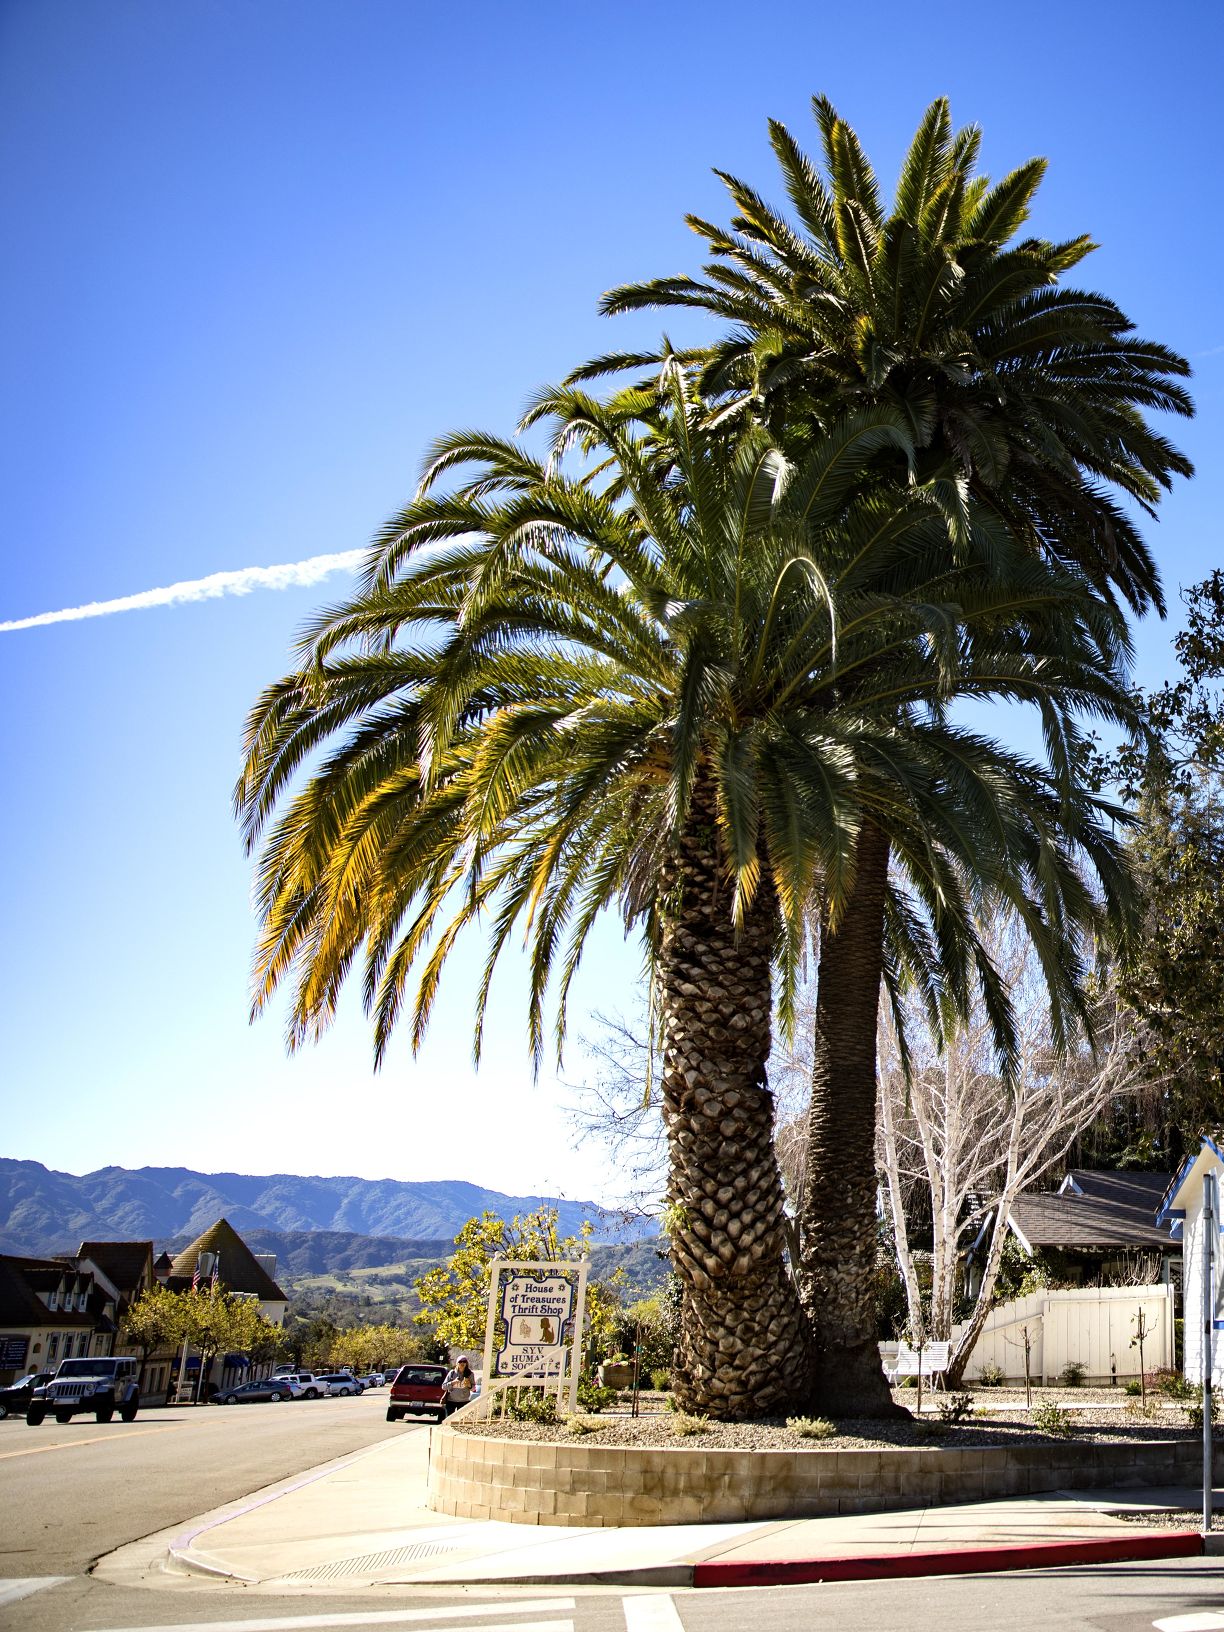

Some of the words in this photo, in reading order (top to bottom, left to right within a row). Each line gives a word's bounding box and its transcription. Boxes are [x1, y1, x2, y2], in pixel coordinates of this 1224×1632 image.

[524, 1283, 554, 1293] House
[509, 1294, 519, 1303] of
[521, 1294, 567, 1304] Treasures
[511, 1304, 539, 1314] Thrift
[540, 1304, 564, 1316] Shop
[511, 1354, 554, 1363] HUMA
